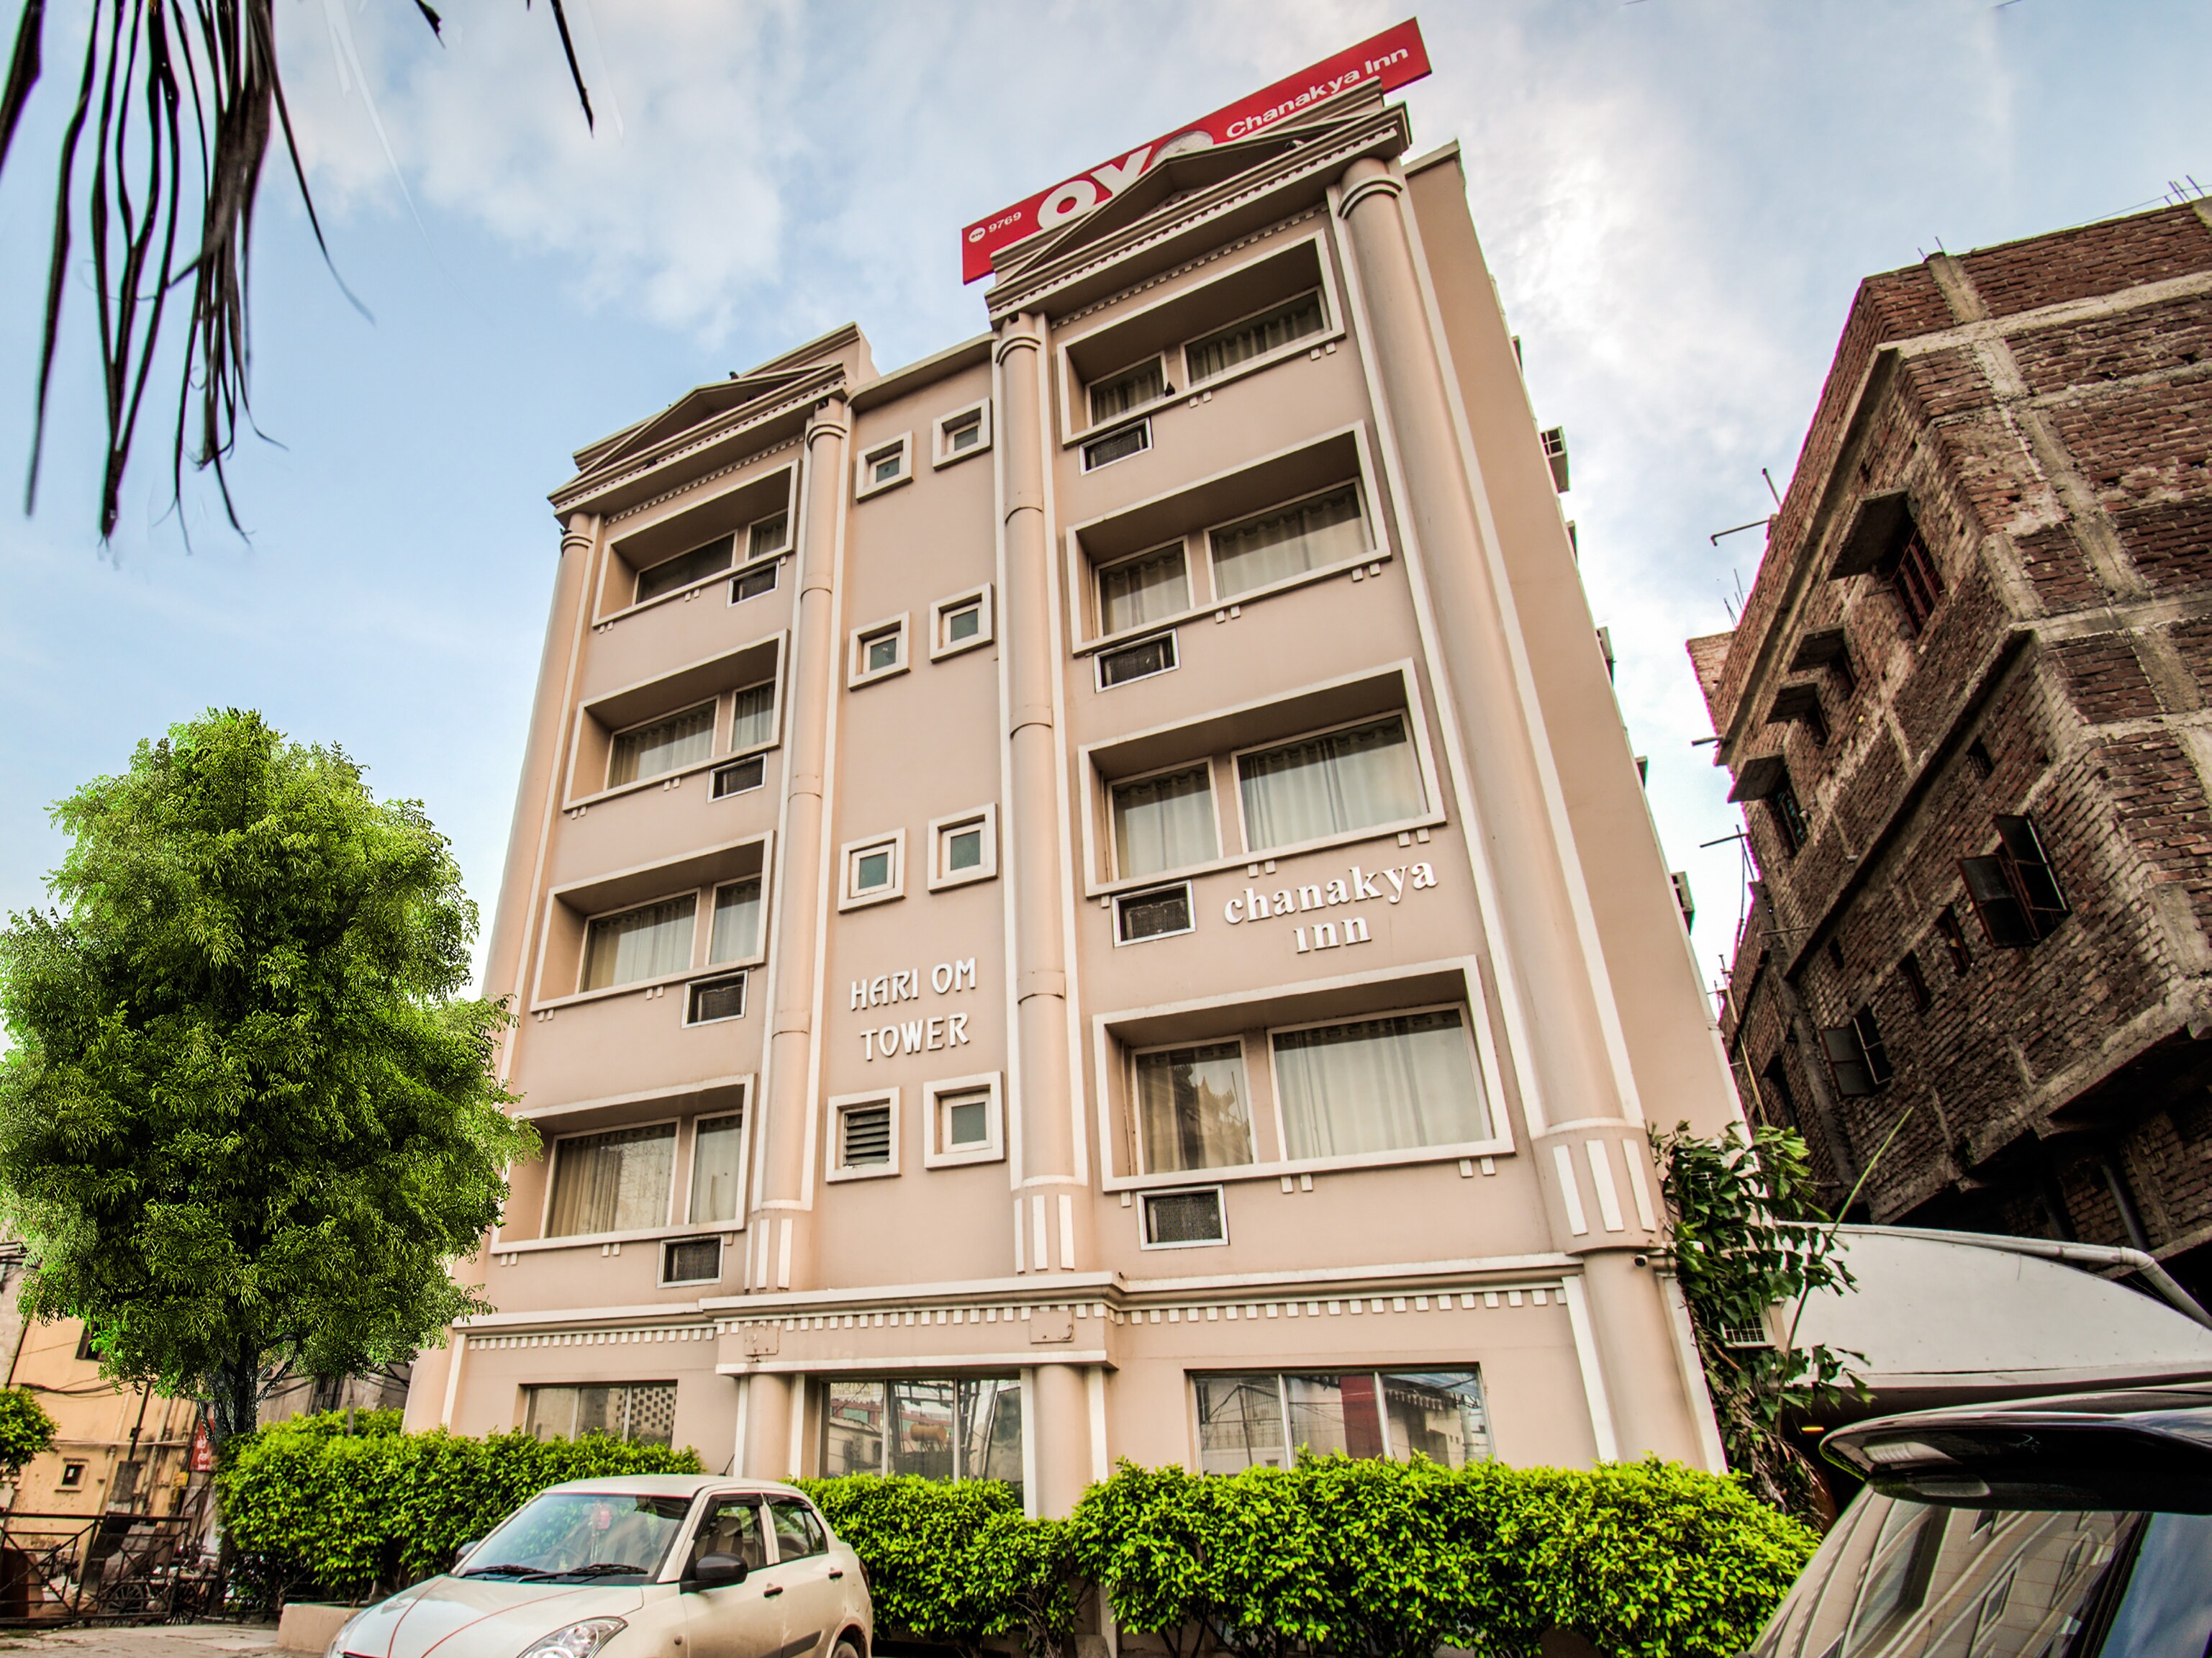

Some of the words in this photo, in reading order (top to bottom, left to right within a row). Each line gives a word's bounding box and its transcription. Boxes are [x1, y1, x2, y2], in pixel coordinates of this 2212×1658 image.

[1225, 69, 1361, 138] Chanakya
[1364, 47, 1409, 75] Inn
[989, 211, 1022, 232] 9769
[1224, 861, 1438, 925] chanakya
[851, 968, 919, 1012] HARI
[931, 956, 976, 995] OM
[860, 1012, 970, 1062] TOWER
